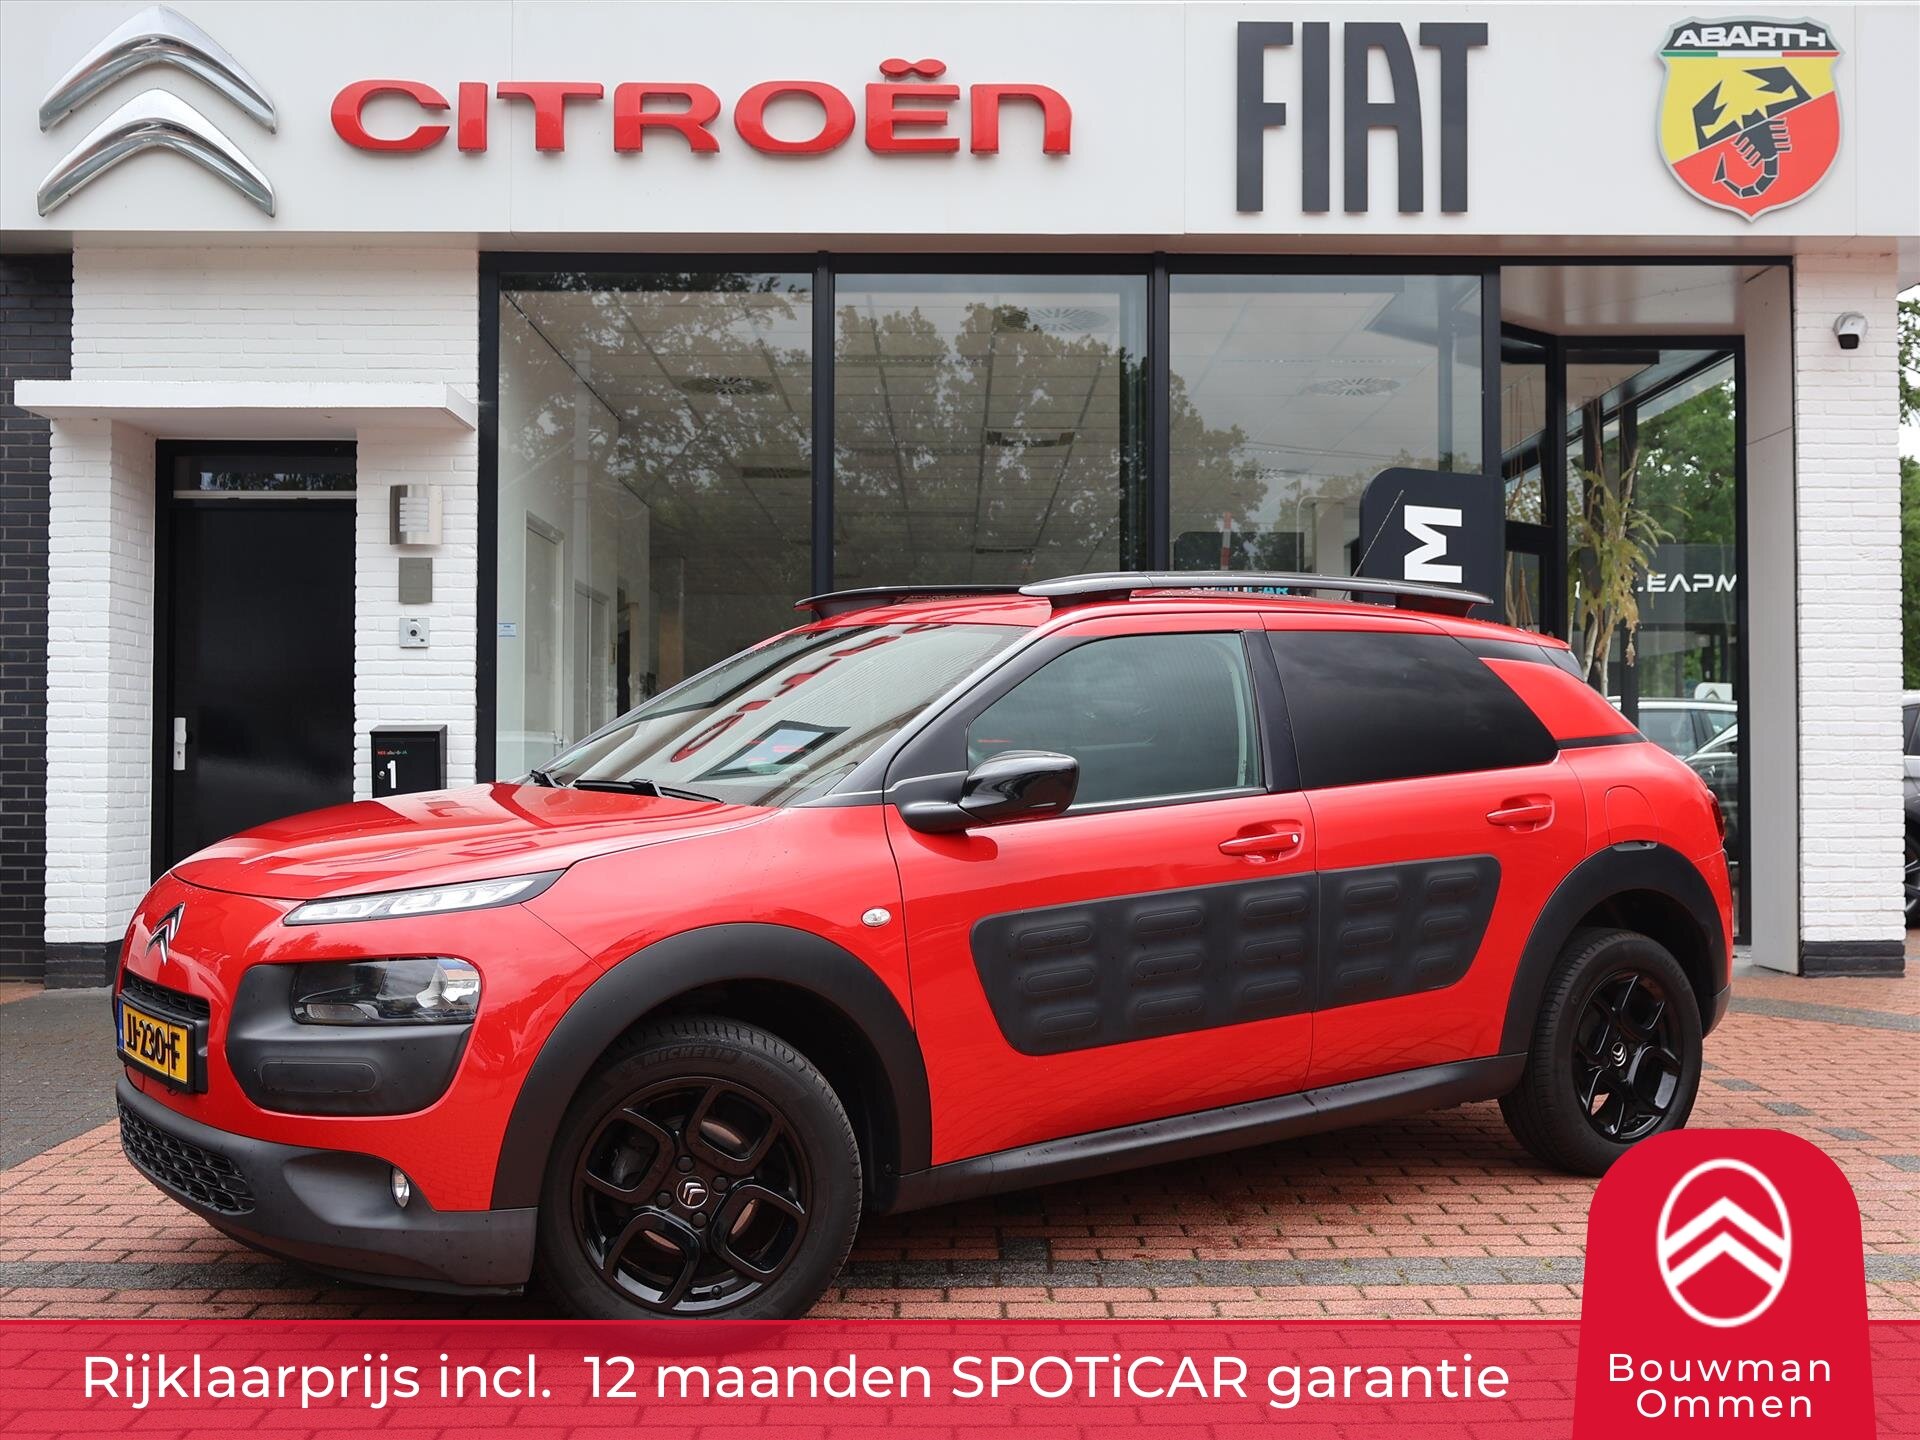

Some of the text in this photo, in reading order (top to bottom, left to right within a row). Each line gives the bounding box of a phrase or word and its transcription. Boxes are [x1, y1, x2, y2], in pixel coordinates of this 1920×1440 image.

[1673, 25, 1826, 48] ABARTH
[331, 58, 1072, 155] CITROËN
[1237, 22, 1487, 213] FIAT
[387, 760, 397, 789] 1
[126, 1013, 180, 1071] JJ-230-F
